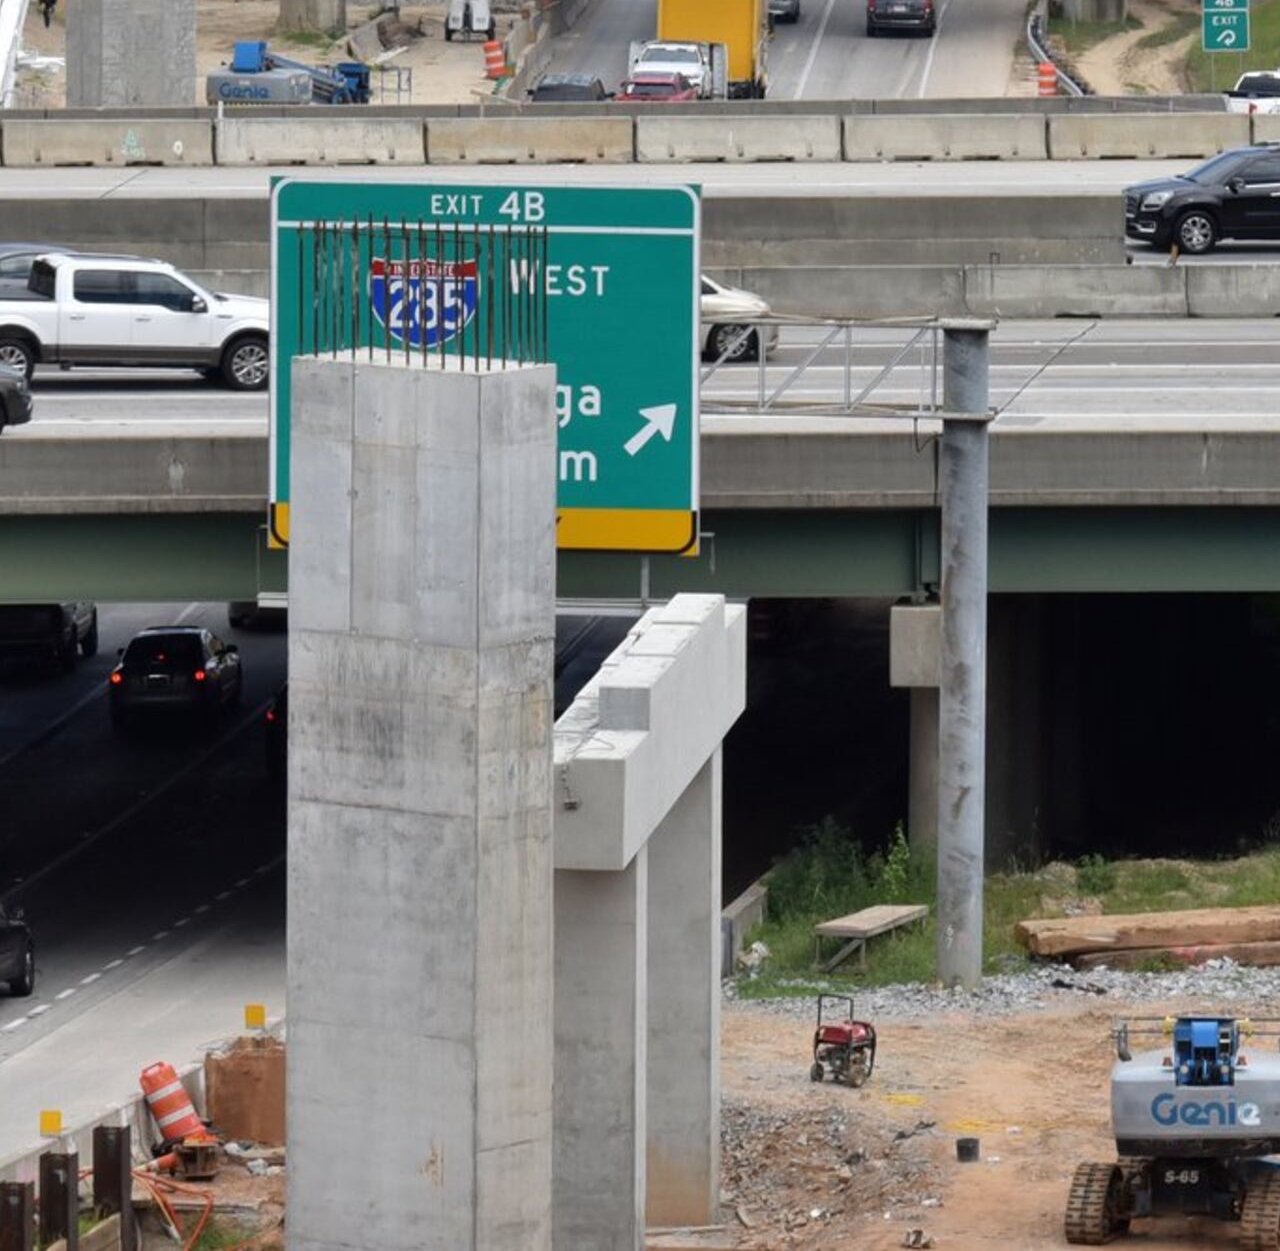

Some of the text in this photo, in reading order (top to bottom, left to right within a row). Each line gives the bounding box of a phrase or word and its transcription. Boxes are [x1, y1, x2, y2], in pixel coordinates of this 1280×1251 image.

[1212, 15, 1238, 26] EXIT
[431, 191, 545, 221] EXIT 4B
[510, 259, 610, 296] WEST
[389, 280, 468, 329] 285
[1151, 1092, 1261, 1126] Genie
[1165, 1171, 1199, 1184] S-65
